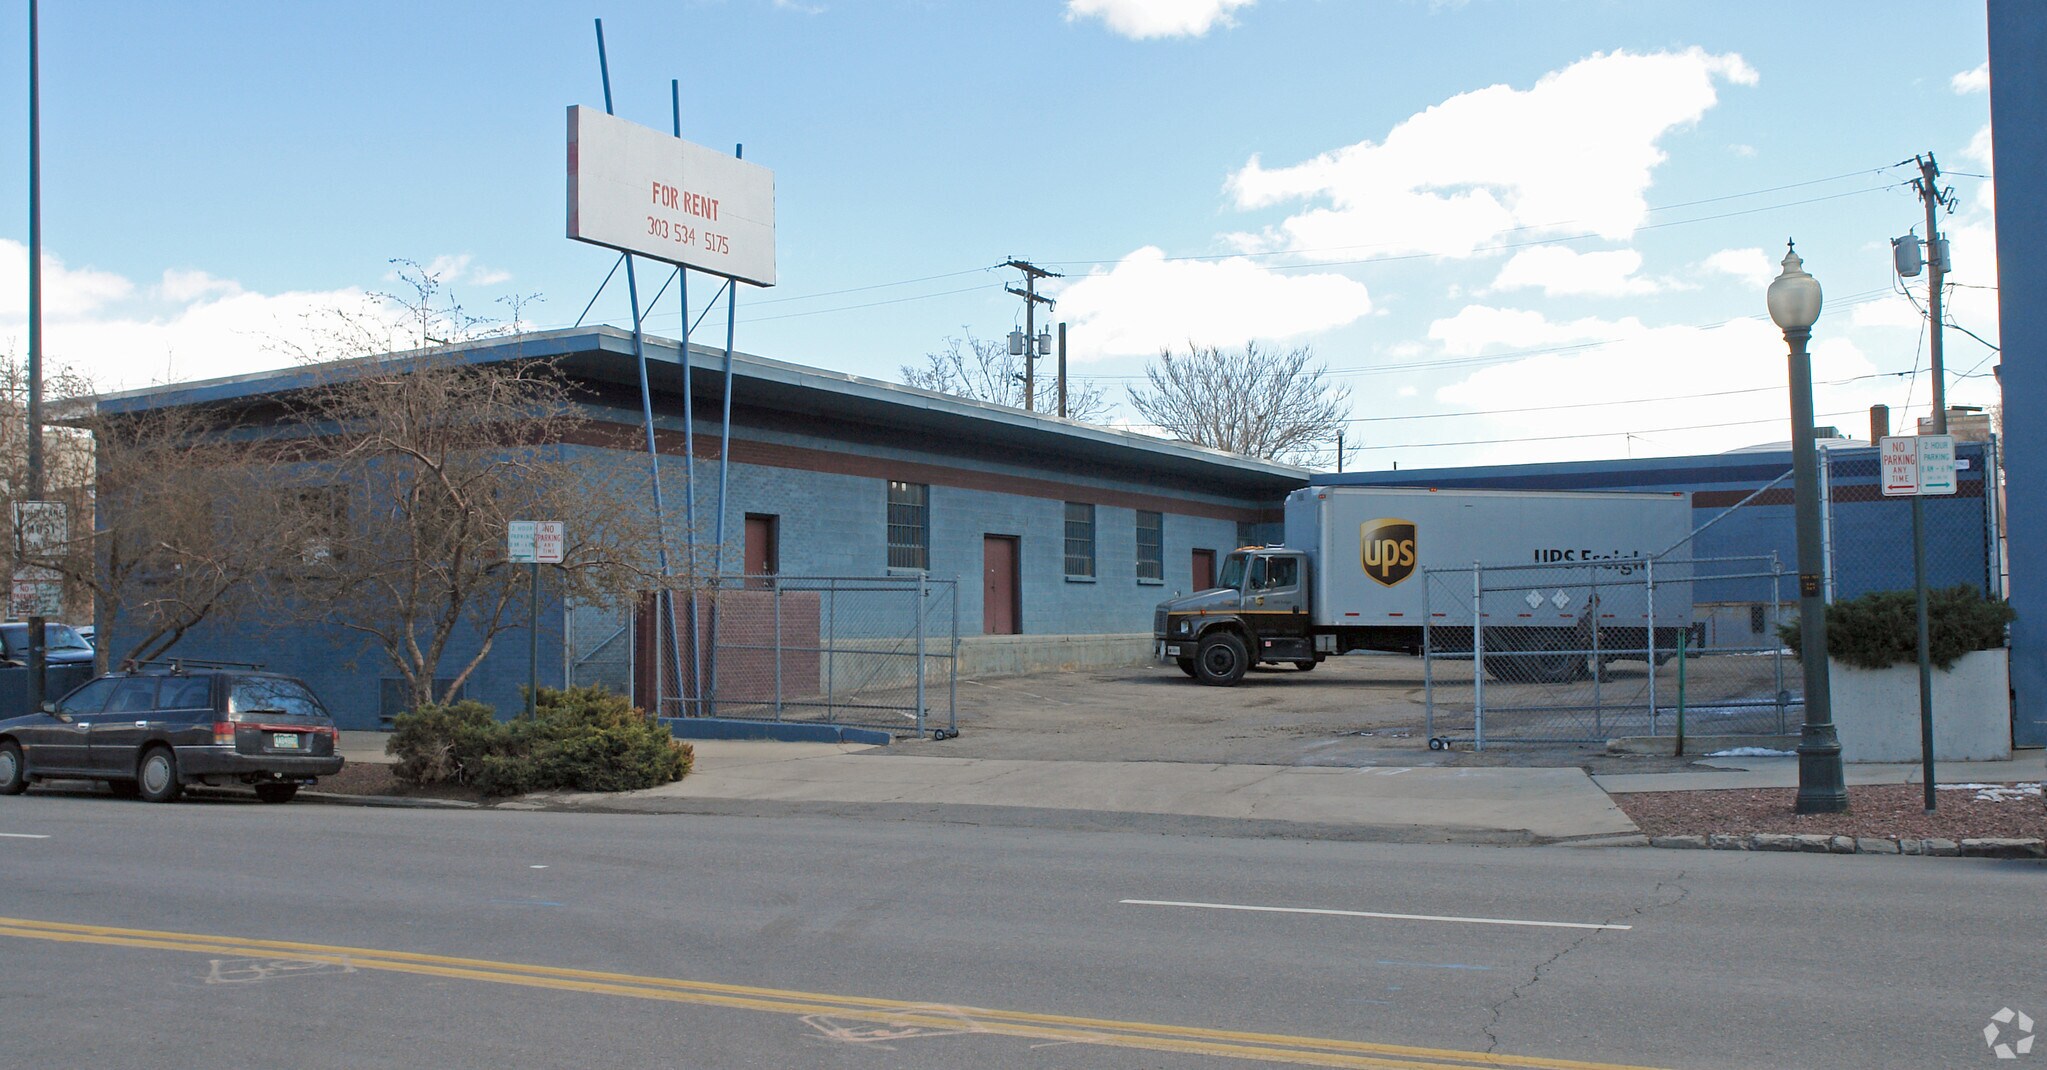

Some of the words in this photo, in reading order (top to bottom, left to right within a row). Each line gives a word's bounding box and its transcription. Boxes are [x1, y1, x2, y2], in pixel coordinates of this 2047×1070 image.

[652, 181, 679, 211] FOR
[684, 191, 719, 221] RENT
[647, 216, 669, 239] 303
[675, 223, 696, 246] 534
[705, 232, 729, 255] 5175
[1892, 442, 1905, 452] NO
[1884, 454, 1915, 465] PARKING
[1924, 453, 1950, 461] PARKING
[544, 525, 554, 533] NO
[1364, 539, 1414, 577] ups
[1534, 549, 1575, 569] UPS
